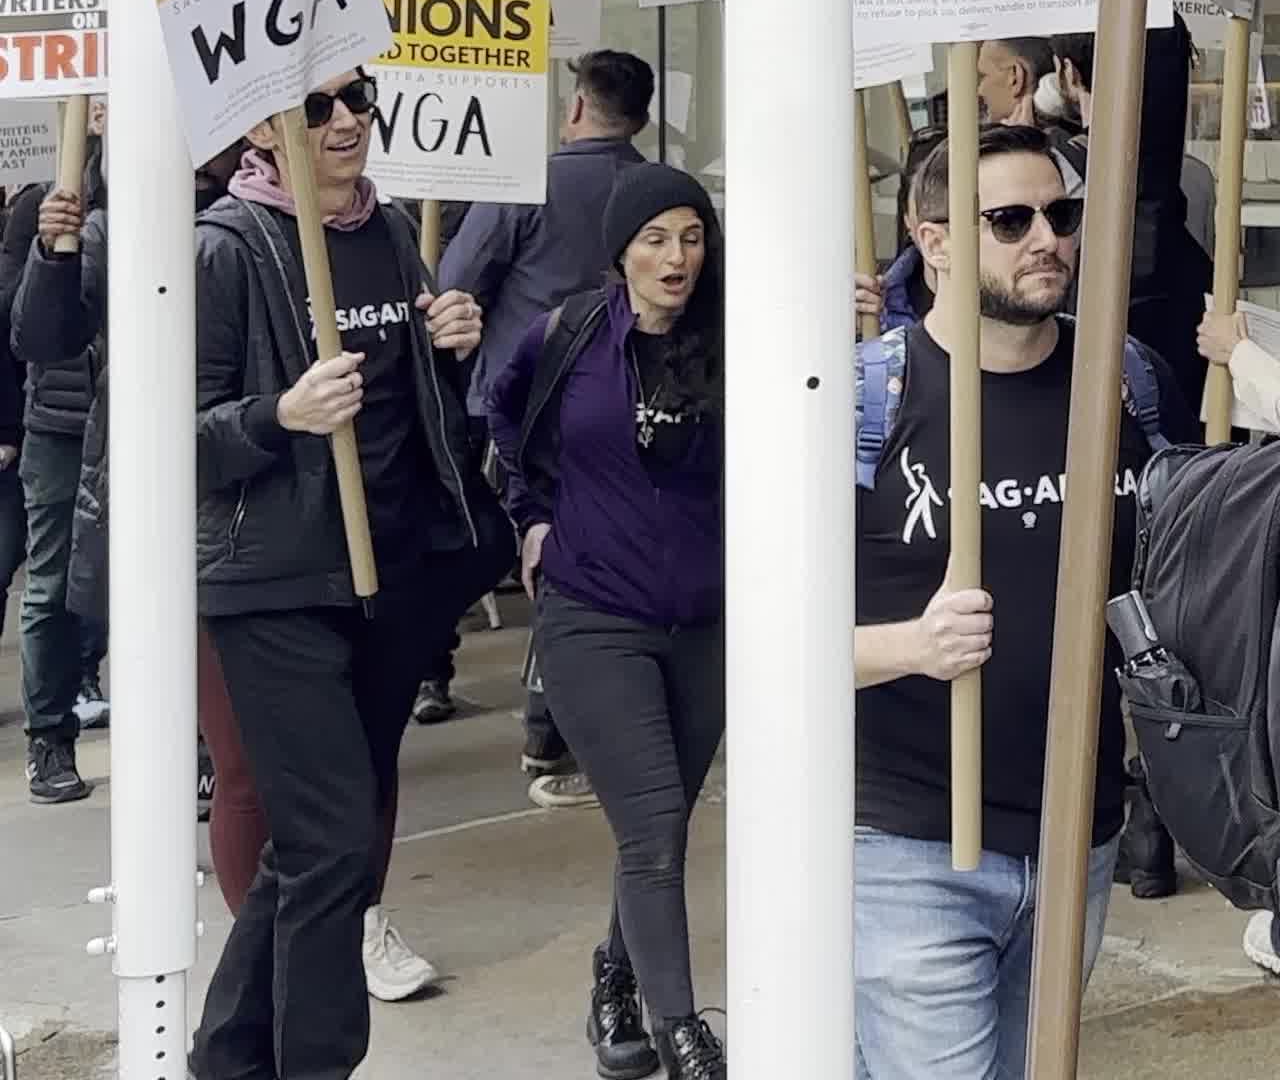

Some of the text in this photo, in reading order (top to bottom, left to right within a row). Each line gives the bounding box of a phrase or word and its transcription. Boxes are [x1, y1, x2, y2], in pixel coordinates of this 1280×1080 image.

[72, 14, 99, 30] ON
[0, 32, 107, 85] TRI
[407, 43, 531, 68] TOGETHER
